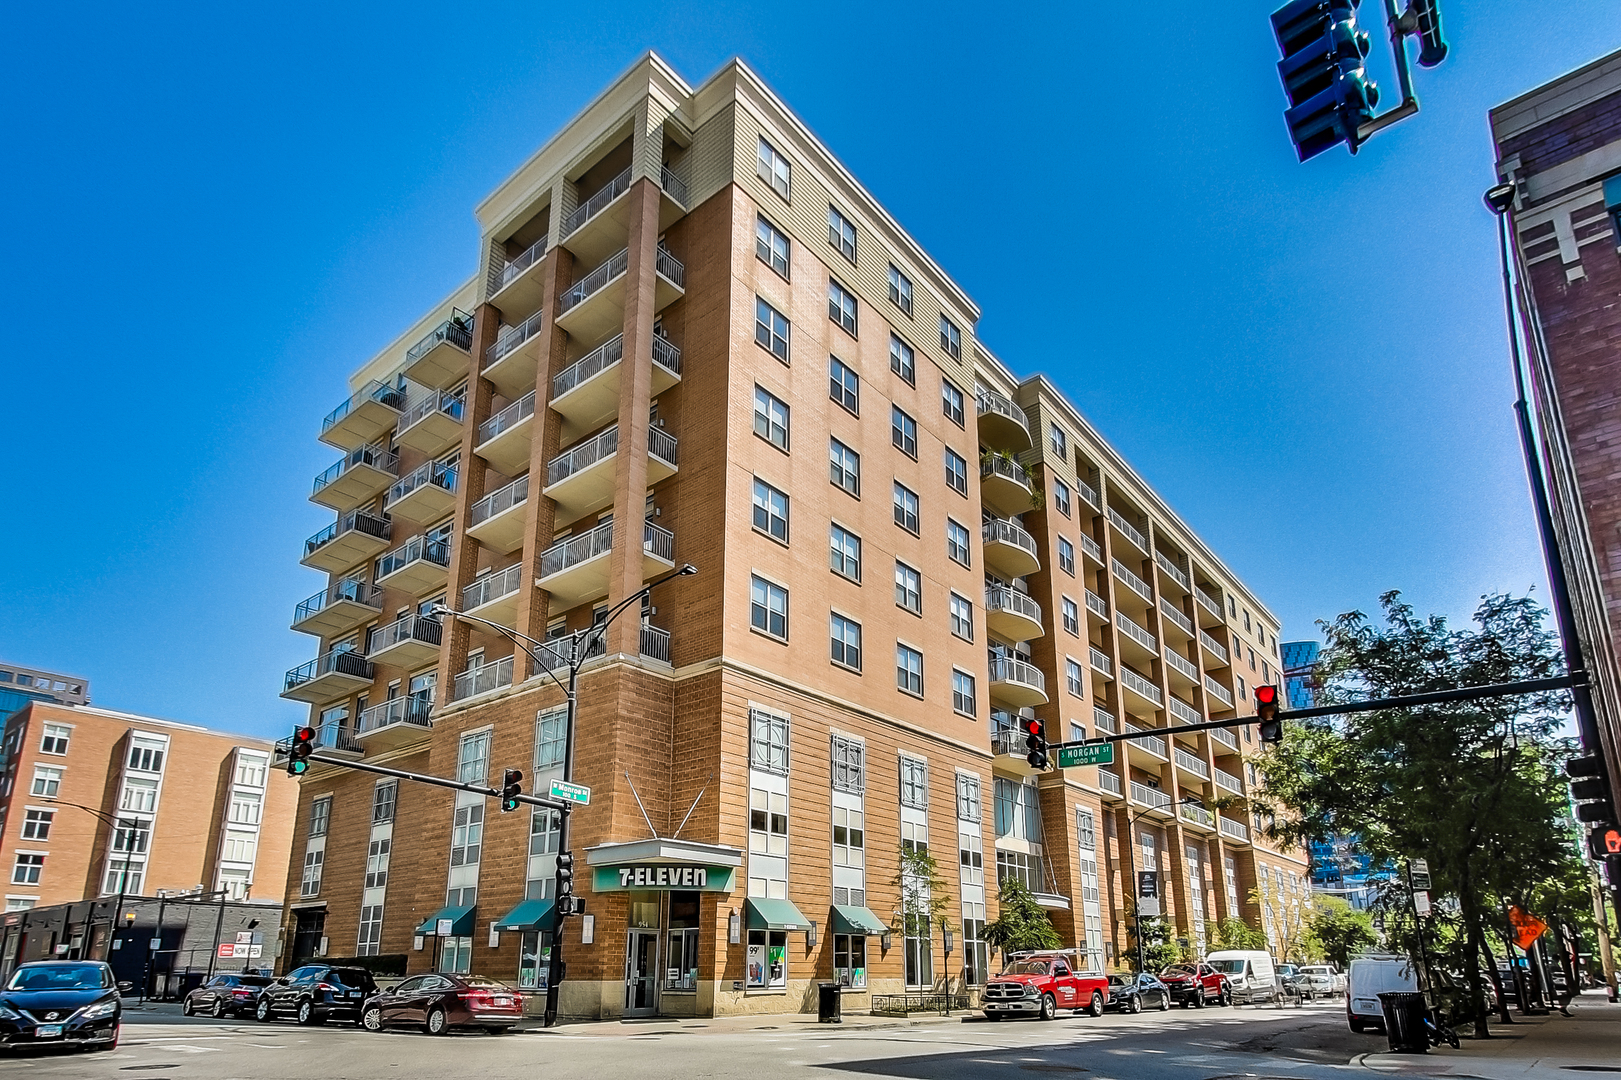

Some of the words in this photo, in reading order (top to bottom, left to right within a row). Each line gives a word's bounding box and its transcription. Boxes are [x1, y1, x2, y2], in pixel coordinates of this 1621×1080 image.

[1067, 746, 1100, 758] MORGAN
[1073, 757, 1089, 765] 1000
[558, 783, 582, 795] Monroe
[234, 947, 246, 955] NOW
